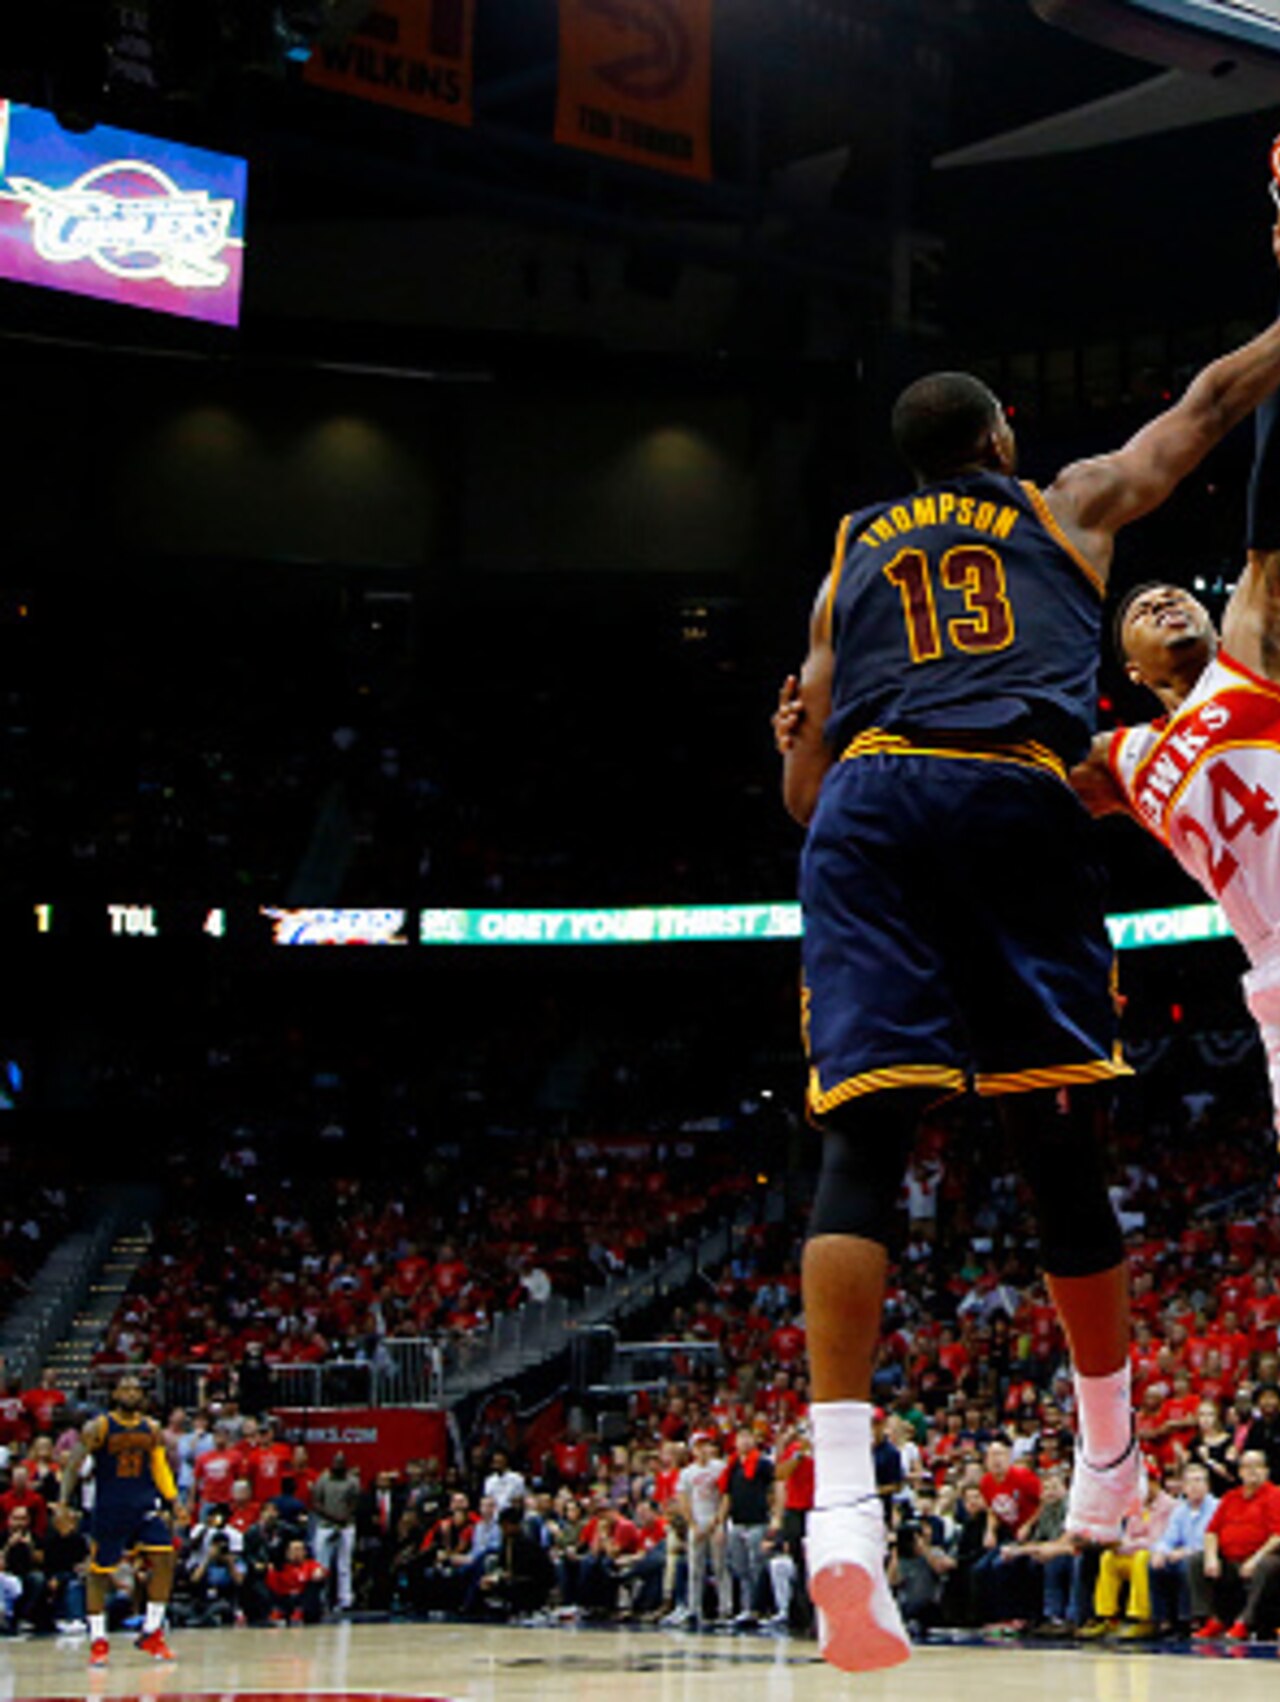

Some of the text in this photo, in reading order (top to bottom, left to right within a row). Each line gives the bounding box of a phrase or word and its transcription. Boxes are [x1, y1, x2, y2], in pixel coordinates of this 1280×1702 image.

[322, 43, 460, 104] WILKINS
[858, 493, 1019, 547] THOMPSON
[882, 545, 1015, 663] 13
[1177, 759, 1279, 897] 24
[203, 908, 226, 937] 4
